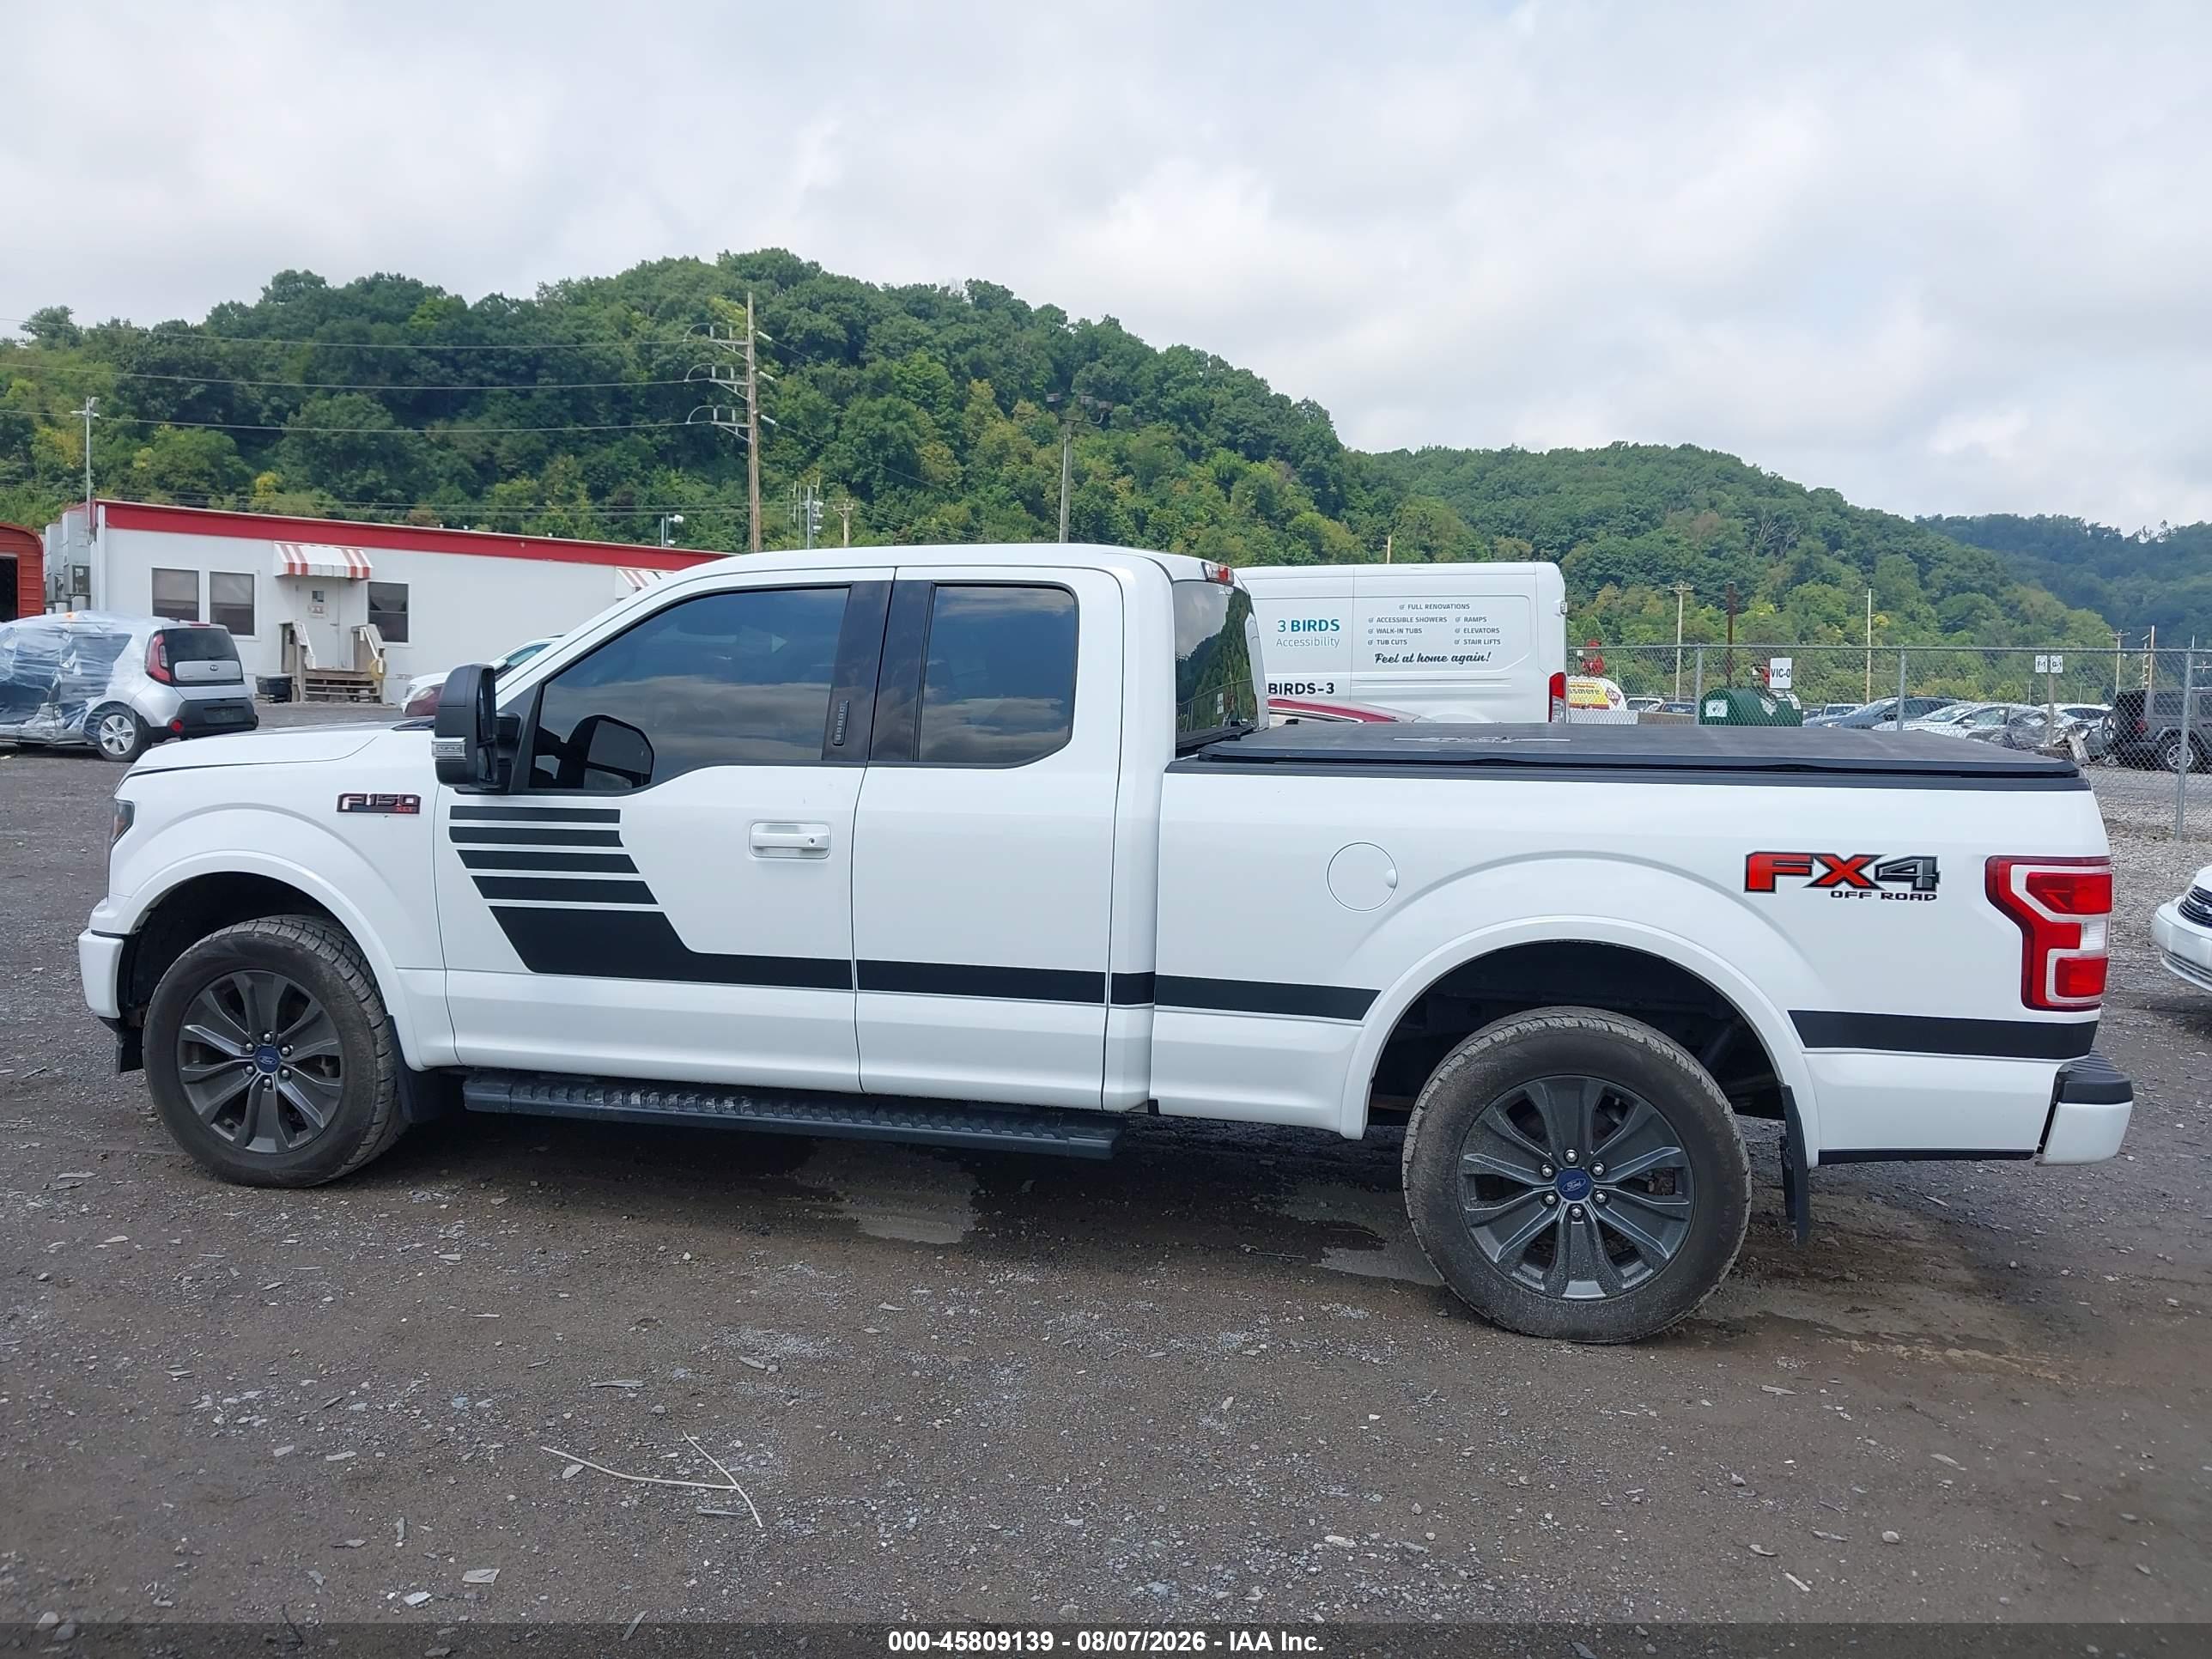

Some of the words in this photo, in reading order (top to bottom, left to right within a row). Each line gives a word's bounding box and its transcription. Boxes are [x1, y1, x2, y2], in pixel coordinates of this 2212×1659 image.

[1277, 619, 1286, 633] 3
[1291, 618, 1340, 633] BIRDS
[1276, 636, 1340, 648] Accessibility
[1374, 653, 1400, 664] Feel
[1401, 653, 1415, 663] at
[1416, 652, 1449, 663] home
[1451, 651, 1492, 665] again!
[1267, 683, 1335, 695] BIRDS-3
[1744, 851, 1941, 894] FX4
[1830, 890, 1873, 900] OFF
[1881, 891, 1938, 902] ROAD
